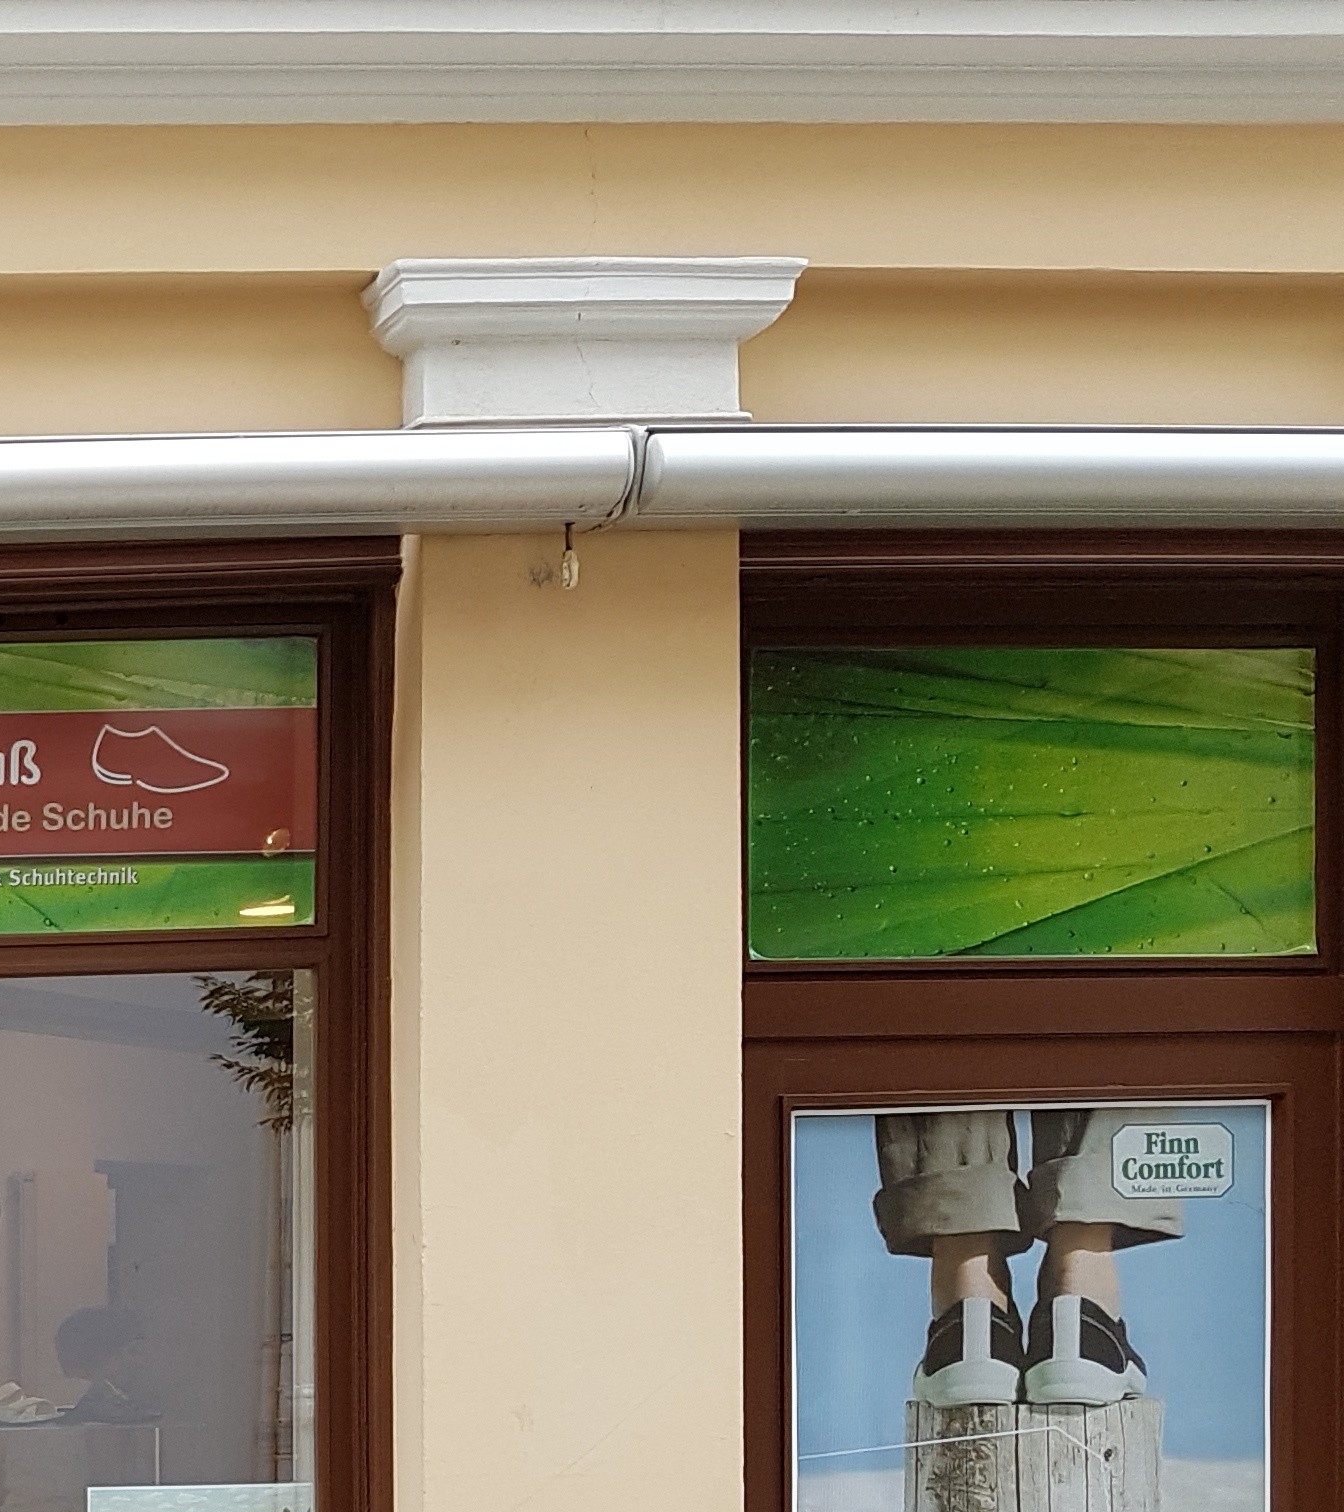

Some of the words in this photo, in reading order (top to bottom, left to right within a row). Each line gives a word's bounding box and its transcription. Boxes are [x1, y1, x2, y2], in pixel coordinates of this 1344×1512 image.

[42, 802, 173, 831] Schuhe
[9, 867, 138, 887] Schuhtechnik
[1144, 1131, 1200, 1155] Finn
[1121, 1154, 1224, 1181] Comfort
